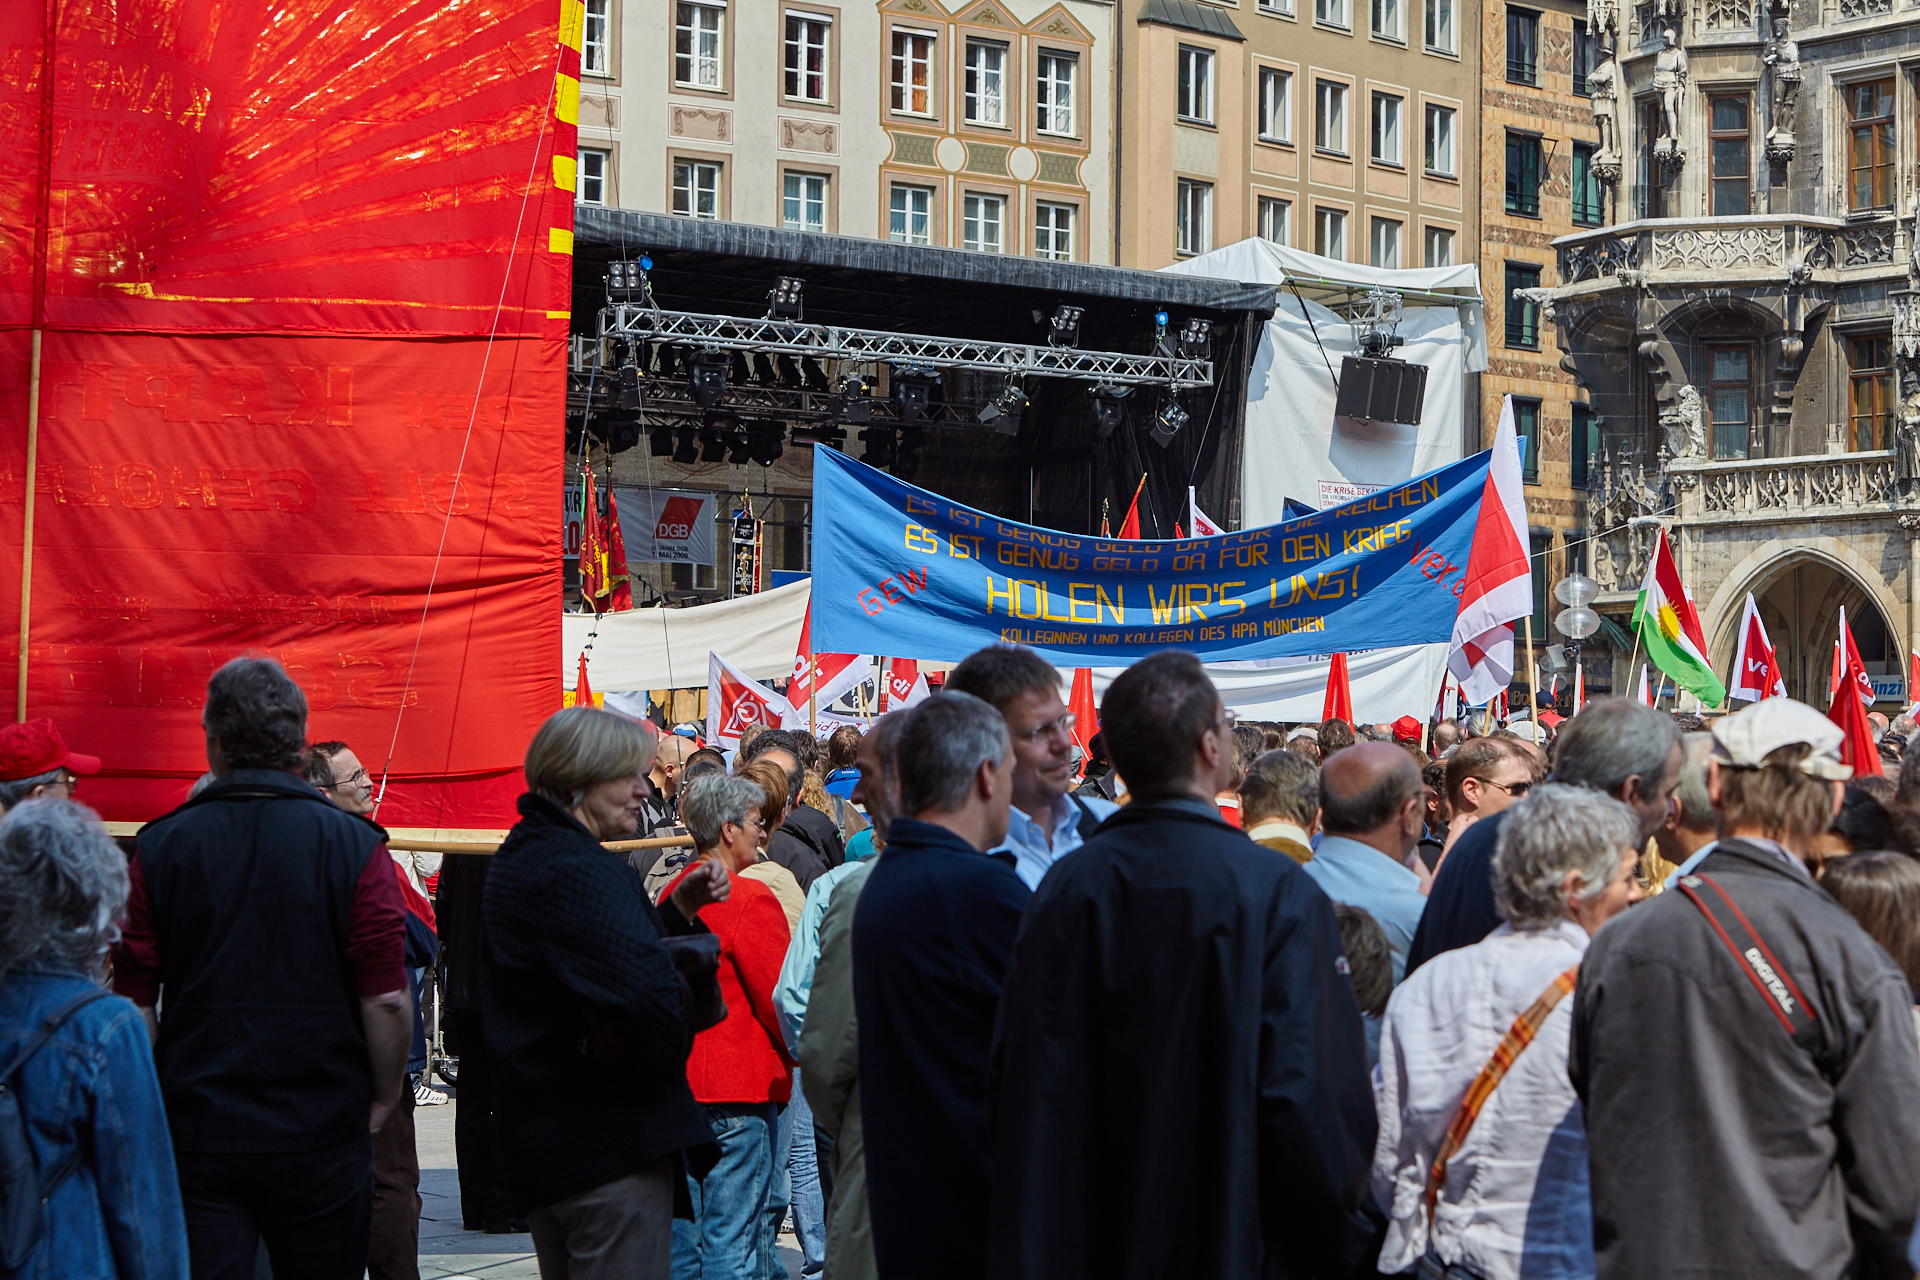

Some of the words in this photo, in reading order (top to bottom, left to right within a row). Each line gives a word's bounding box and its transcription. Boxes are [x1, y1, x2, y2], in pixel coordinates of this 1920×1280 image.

[1321, 485, 1332, 494] DIE
[1334, 486, 1355, 495] KRISE
[659, 523, 689, 538] DGB
[905, 524, 938, 554] ES
[949, 533, 985, 559] IST
[997, 541, 1080, 571] GENUG
[1093, 557, 1159, 572] GELD
[1172, 553, 1206, 572] DA
[1219, 542, 1269, 569] FÜR
[1282, 532, 1331, 563] DEN
[1343, 519, 1412, 555] KRIEG
[906, 494, 937, 516] ES
[949, 507, 985, 528] IST
[997, 522, 1081, 550] GENUG
[673, 552, 689, 560] 2009
[856, 566, 928, 616] GEW
[986, 576, 1124, 625] HOLEN
[1148, 581, 1246, 625] WIR'S
[1269, 564, 1359, 609] UNS!
[1001, 628, 1087, 646] KOLLEGINNEN
[1093, 633, 1119, 645] UND
[1124, 629, 1194, 645] KOLLEGEN
[1200, 625, 1226, 641] DES
[1232, 622, 1258, 639] HPA
[1263, 616, 1326, 636] MÜNCHEN
[1744, 947, 1795, 1014] DIGITAL
